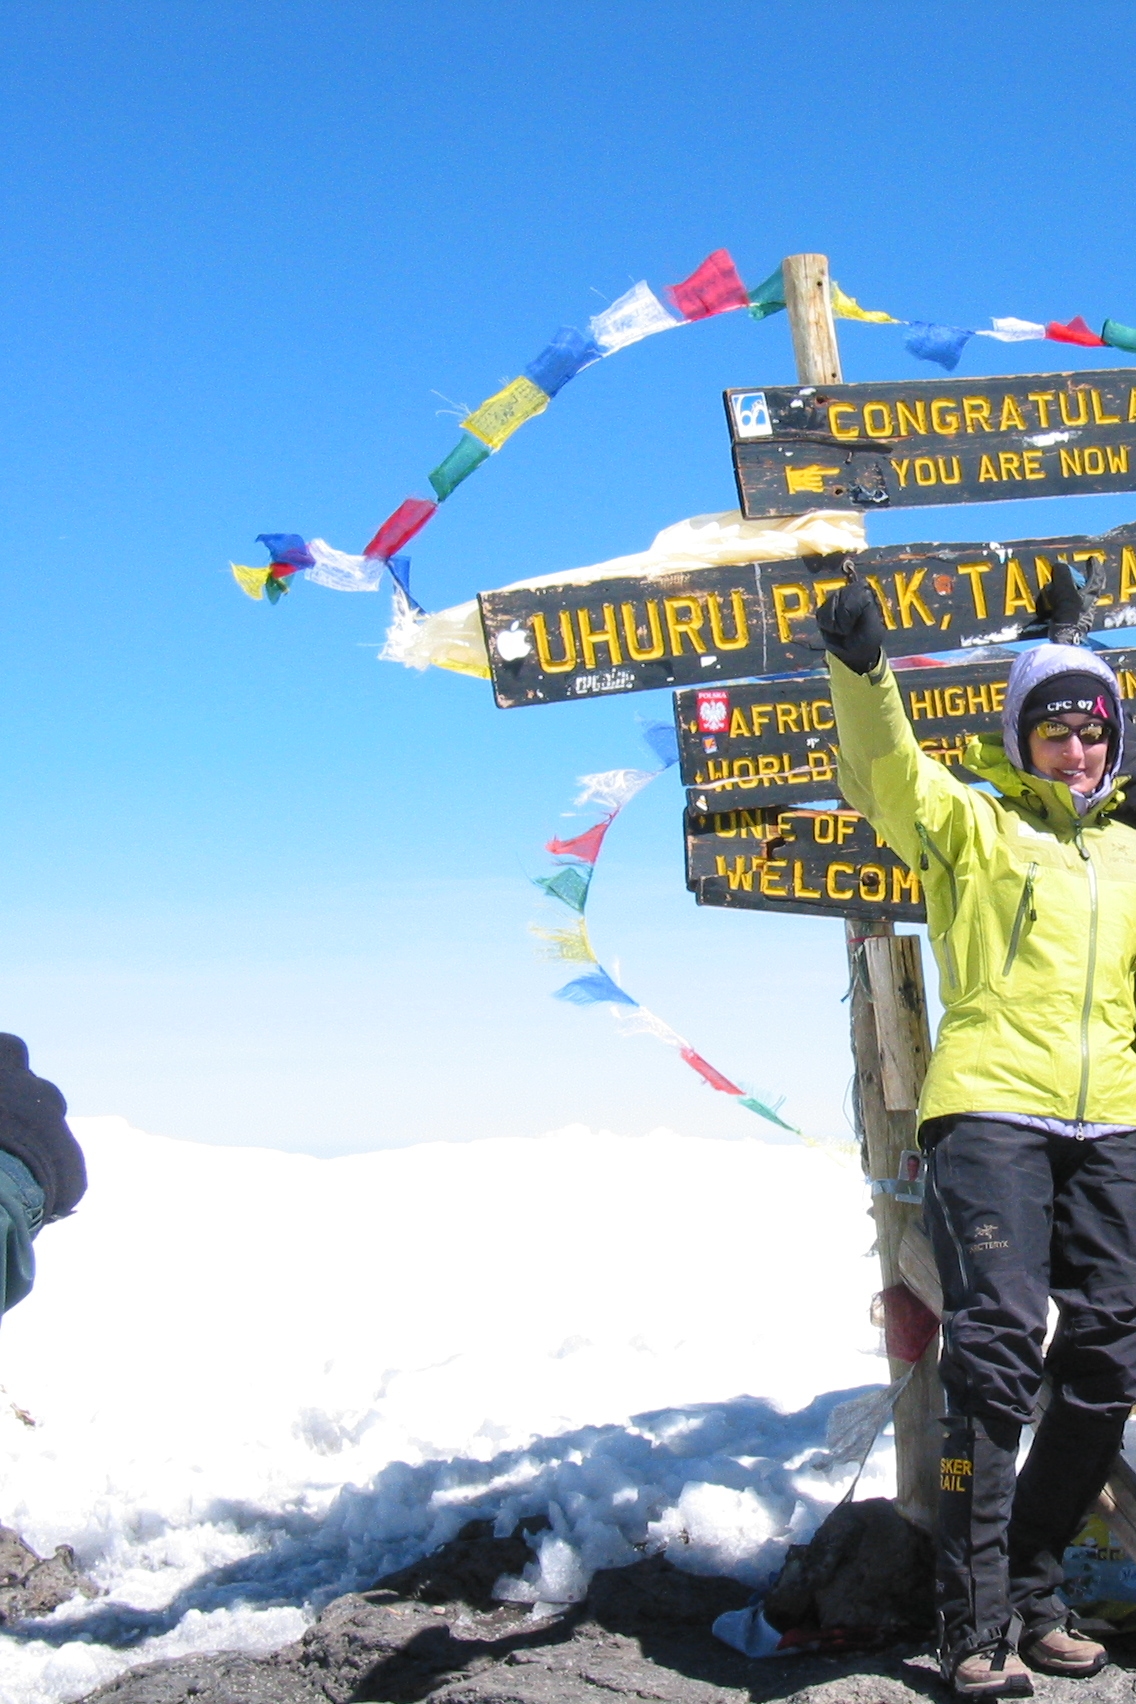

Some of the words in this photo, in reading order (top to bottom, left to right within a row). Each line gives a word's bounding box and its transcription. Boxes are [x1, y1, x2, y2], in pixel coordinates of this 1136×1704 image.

[890, 454, 962, 488] YOU
[978, 449, 1047, 483] ARE
[1059, 443, 1129, 478] NOW
[531, 590, 749, 675] UHURU
[698, 690, 728, 700] POLSKA
[1077, 699, 1094, 712] 07
[814, 813, 860, 845] OF
